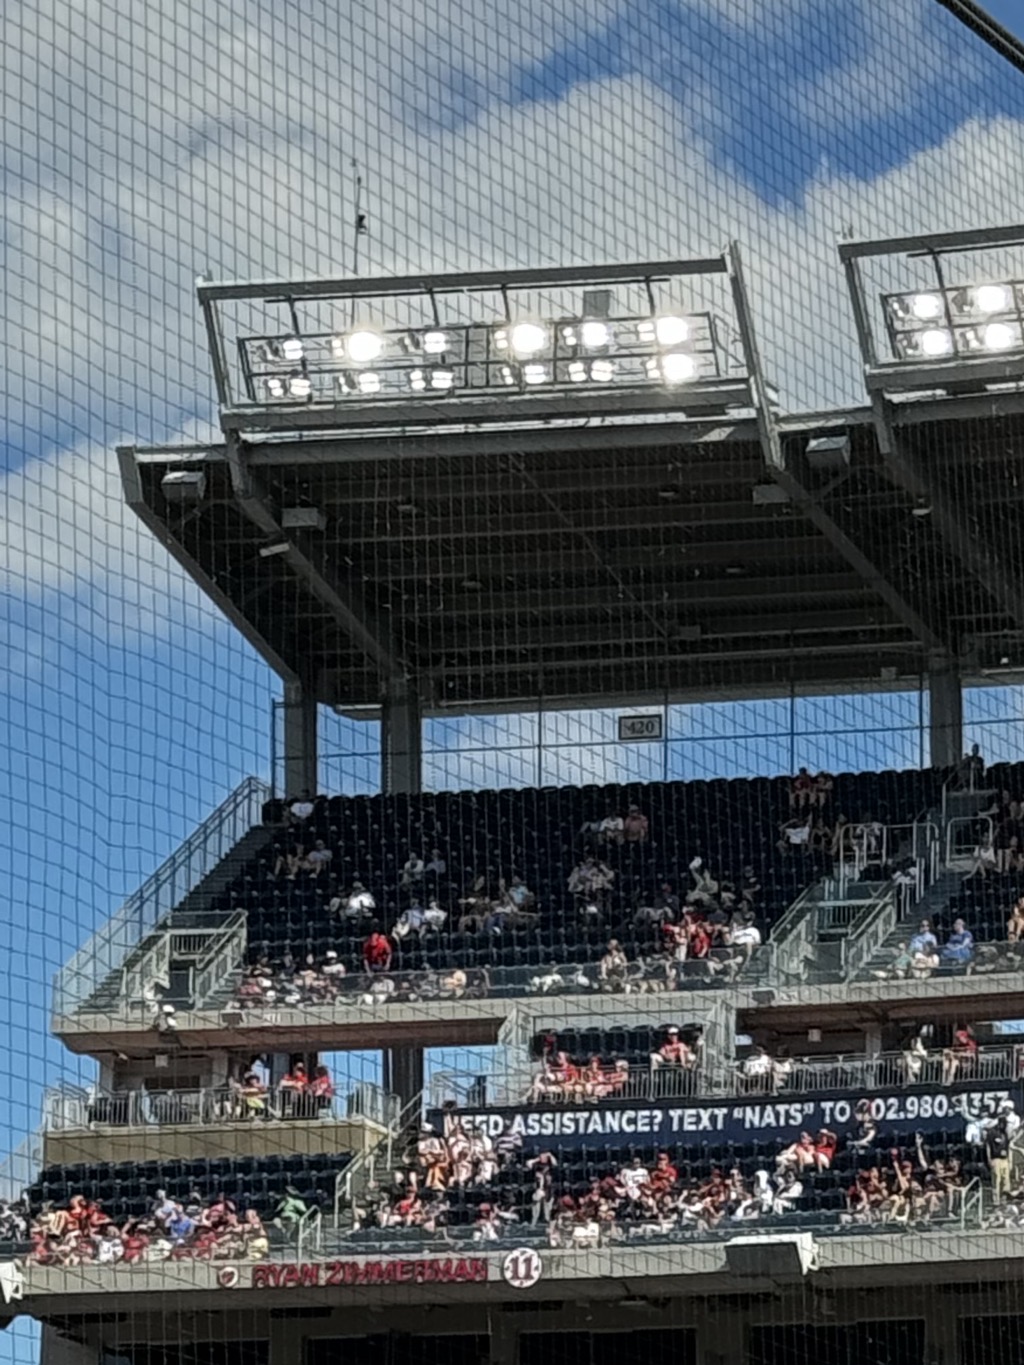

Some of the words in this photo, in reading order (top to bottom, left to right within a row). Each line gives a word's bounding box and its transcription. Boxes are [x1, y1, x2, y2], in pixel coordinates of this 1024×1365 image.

[628, 720, 655, 735] 420
[511, 1109, 663, 1137] ASSISTANCE?
[668, 1107, 728, 1132] TEXT
[820, 1100, 851, 1124] TO
[253, 1263, 319, 1289] RYAN
[510, 1255, 535, 1281] 11
